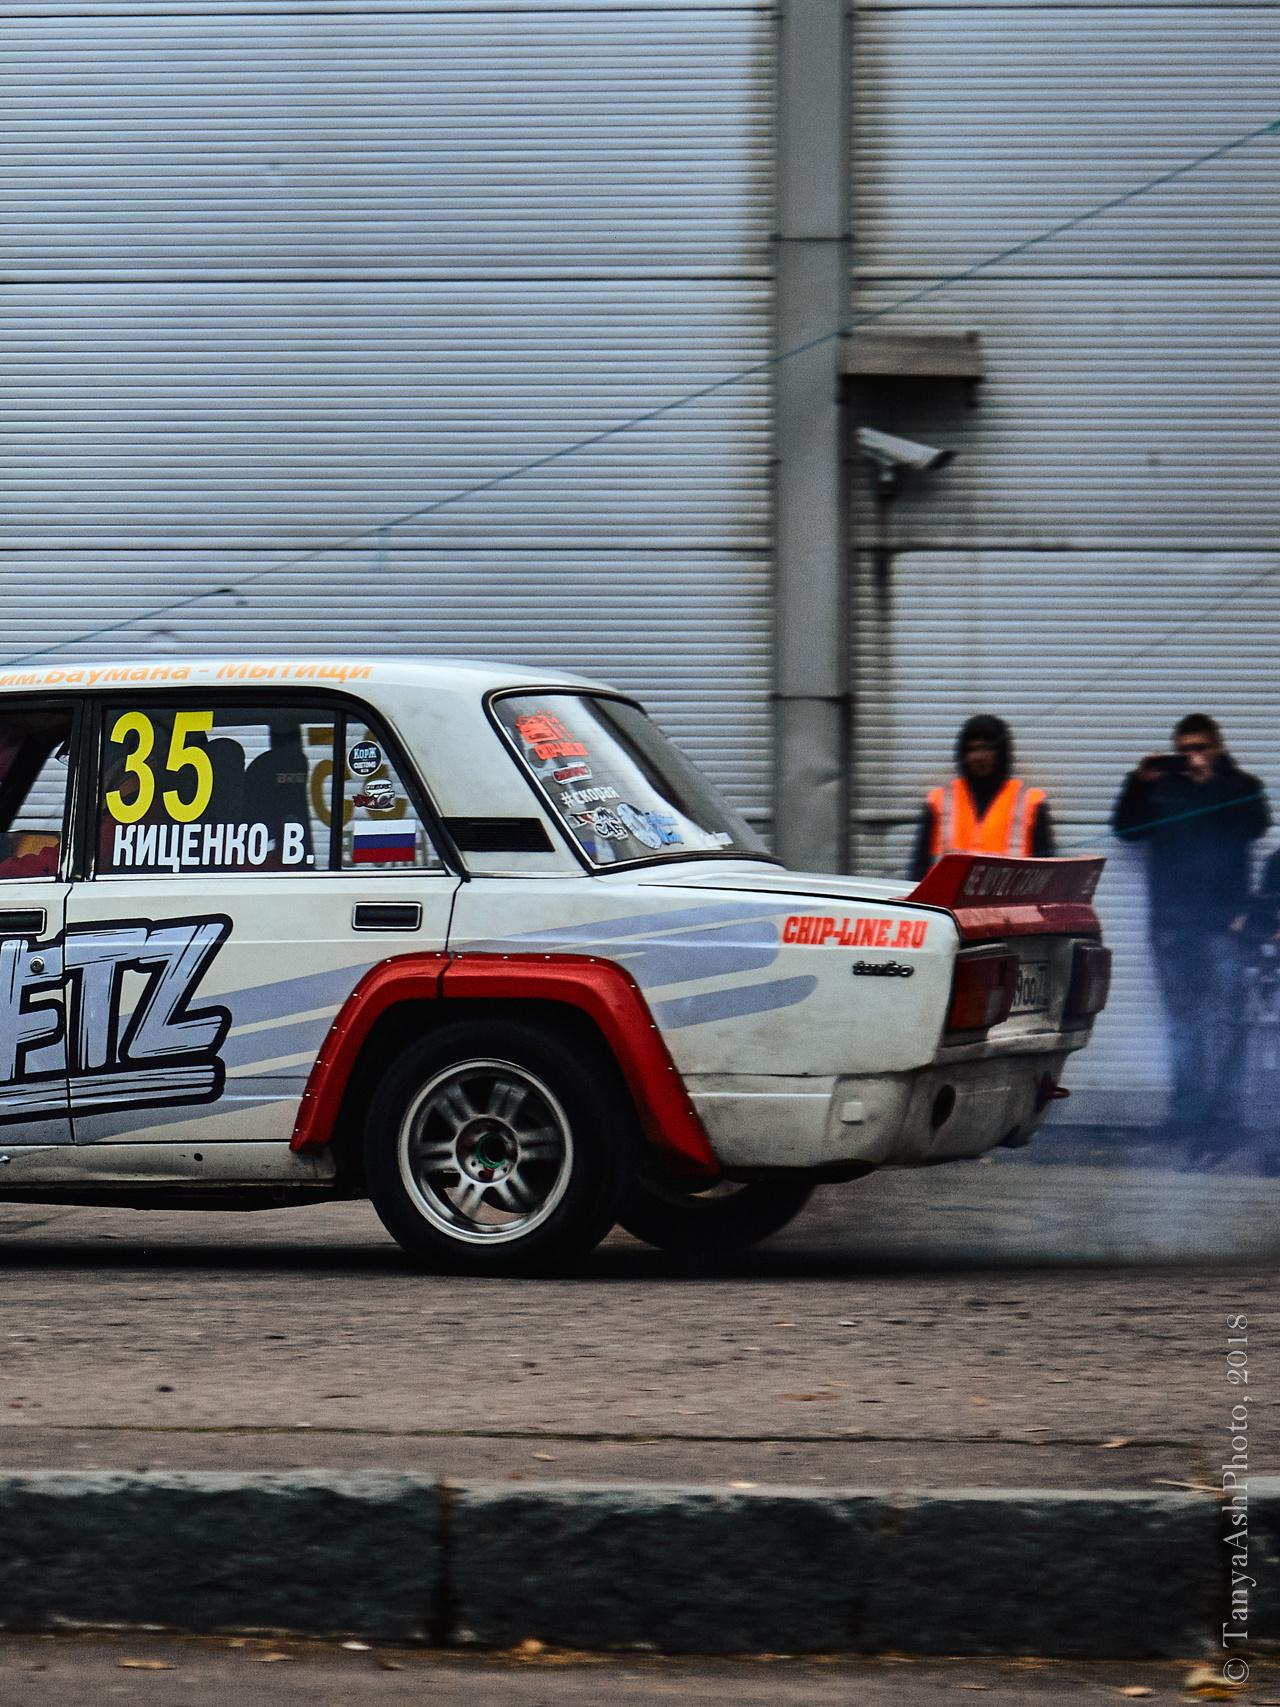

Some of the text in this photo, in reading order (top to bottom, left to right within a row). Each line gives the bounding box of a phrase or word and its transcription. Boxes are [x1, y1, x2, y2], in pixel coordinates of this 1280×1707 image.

[216, 662, 374, 684] Мытищи
[106, 711, 215, 824] 35
[112, 822, 315, 873] КИЦЕНКО В.
[782, 916, 929, 949] CHIP-LINE.RU
